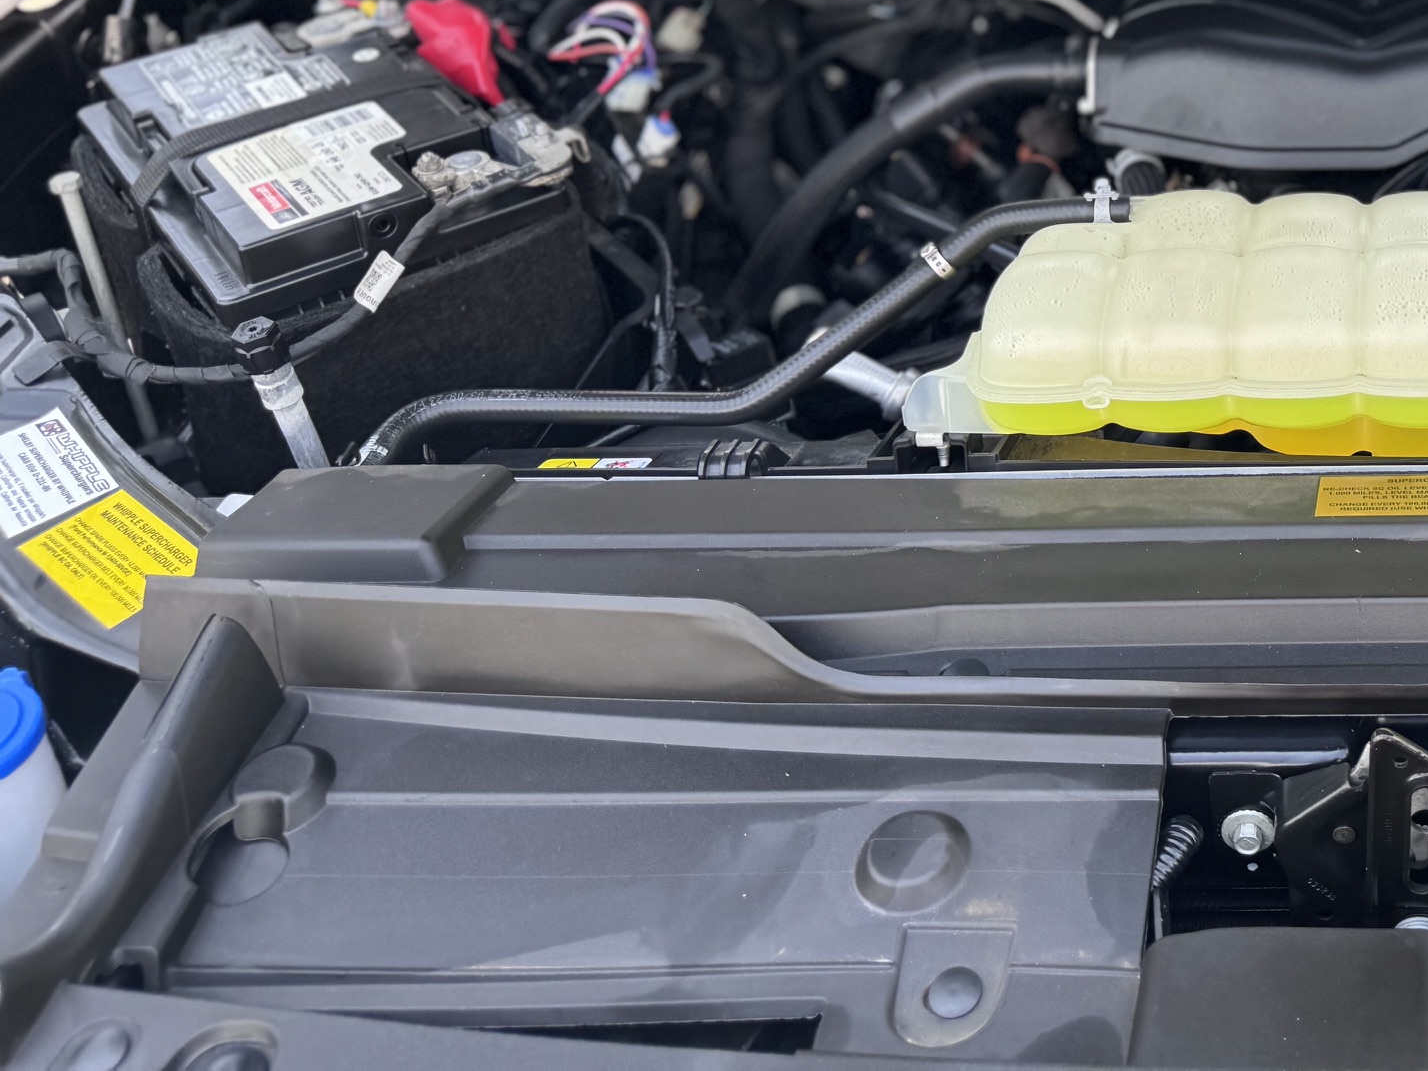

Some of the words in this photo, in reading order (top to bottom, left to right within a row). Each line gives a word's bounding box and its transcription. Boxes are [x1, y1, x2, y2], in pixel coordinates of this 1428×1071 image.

[288, 177, 314, 197] AGM
[17, 431, 34, 448] SHELBY
[17, 451, 31, 465] CARB
[28, 446, 57, 479] SUPERCHARGER
[51, 477, 62, 485] BY
[55, 431, 111, 494] WHIPPLE
[57, 453, 94, 497] Superchargers
[55, 483, 76, 505] WHIPPLE
[74, 517, 93, 532] CHANGE
[89, 529, 106, 542] SPARK
[101, 539, 117, 552] PLUGS
[114, 549, 130, 563] EVERY
[99, 510, 146, 547] MAINTENANCE
[141, 542, 180, 576] SCHEDULE
[111, 501, 143, 526] WHIPPLE
[138, 522, 192, 567] SUPERCHARGER
[44, 533, 64, 549] CHANGE
[59, 546, 95, 575] SUPERCHARGER
[91, 571, 100, 580] OIL
[96, 576, 112, 591] EVERY
[55, 527, 75, 543] CHANGE
[71, 540, 105, 568] SUPERCHARGER
[100, 564, 114, 576] BELT
[109, 572, 126, 587] EVERY
